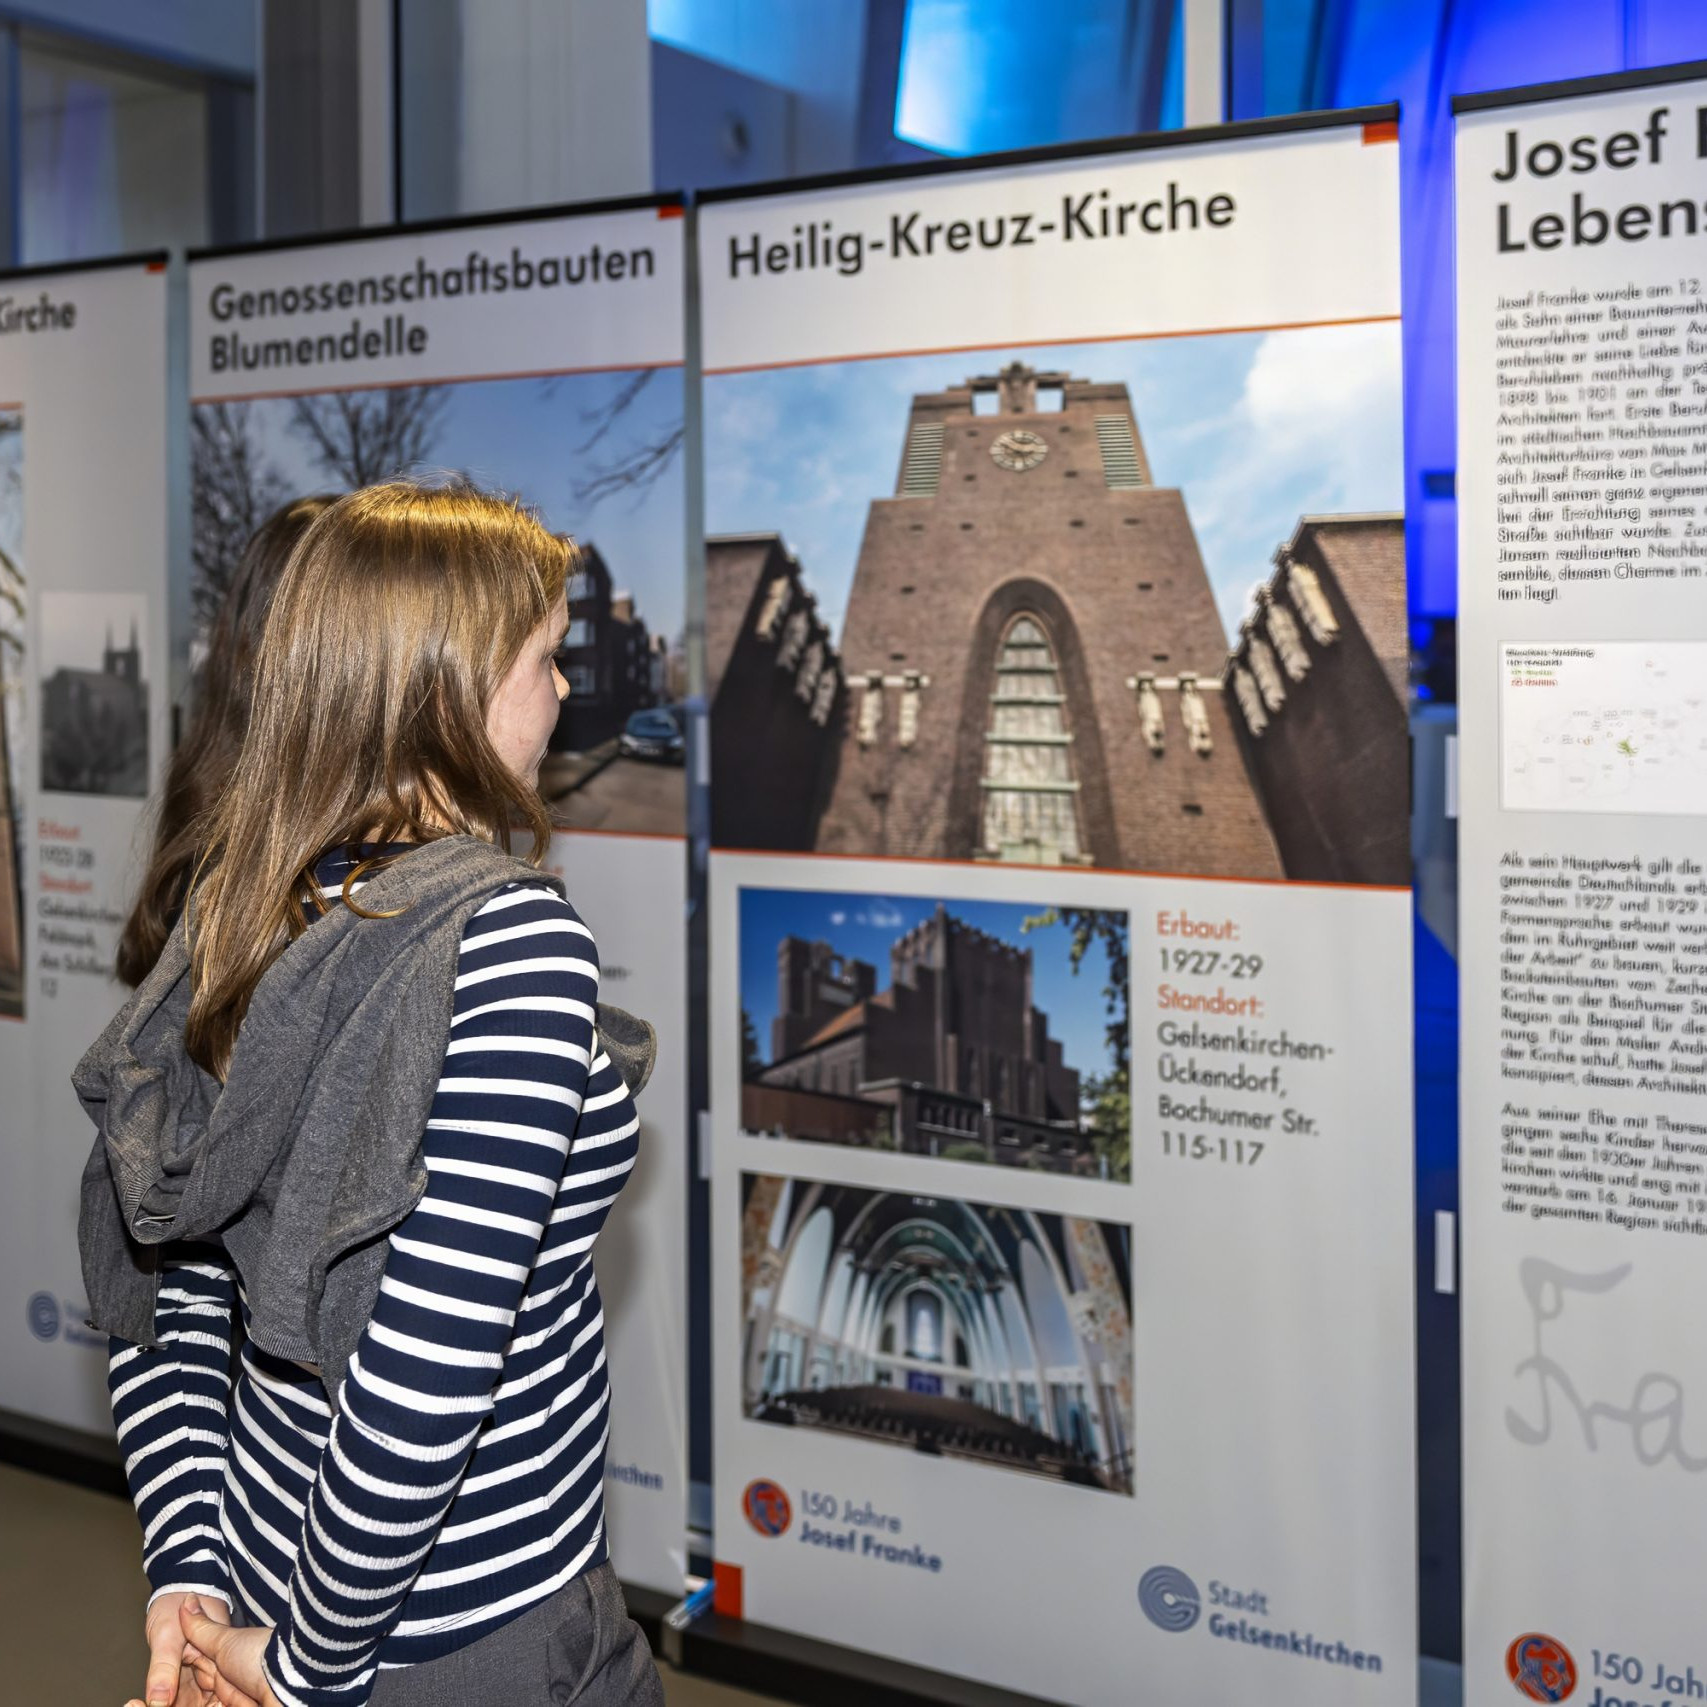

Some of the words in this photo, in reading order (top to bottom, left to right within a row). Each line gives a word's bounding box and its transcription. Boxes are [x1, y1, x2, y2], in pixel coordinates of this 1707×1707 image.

[1492, 106, 1669, 182] Josef
[729, 182, 1236, 278] Heilig-Kreuz-Kirche
[1498, 192, 1707, 253] Leben
[210, 246, 655, 321] Genossenschaftsbauten
[210, 316, 428, 372] Blumendelle
[1157, 910, 1240, 940] Erbaut:
[1160, 947, 1263, 980] 1927-29
[1157, 983, 1265, 1018] Standort:
[1157, 1020, 1334, 1061] Gelsenkirchen-
[1157, 1052, 1287, 1098] Ückendorf,
[1158, 1094, 1274, 1131] Bochumer
[1281, 1108, 1319, 1137] Str.
[1161, 1130, 1265, 1166] 115-117
[801, 1490, 838, 1520] 150
[842, 1500, 902, 1533] Jahre
[800, 1521, 855, 1552] Josef
[862, 1534, 943, 1573] Franke
[1208, 1580, 1269, 1615] Stadt
[1208, 1613, 1382, 1674] Gelsenkirchen
[1591, 1649, 1643, 1685] 150
[1650, 1663, 1707, 1699] Jah
